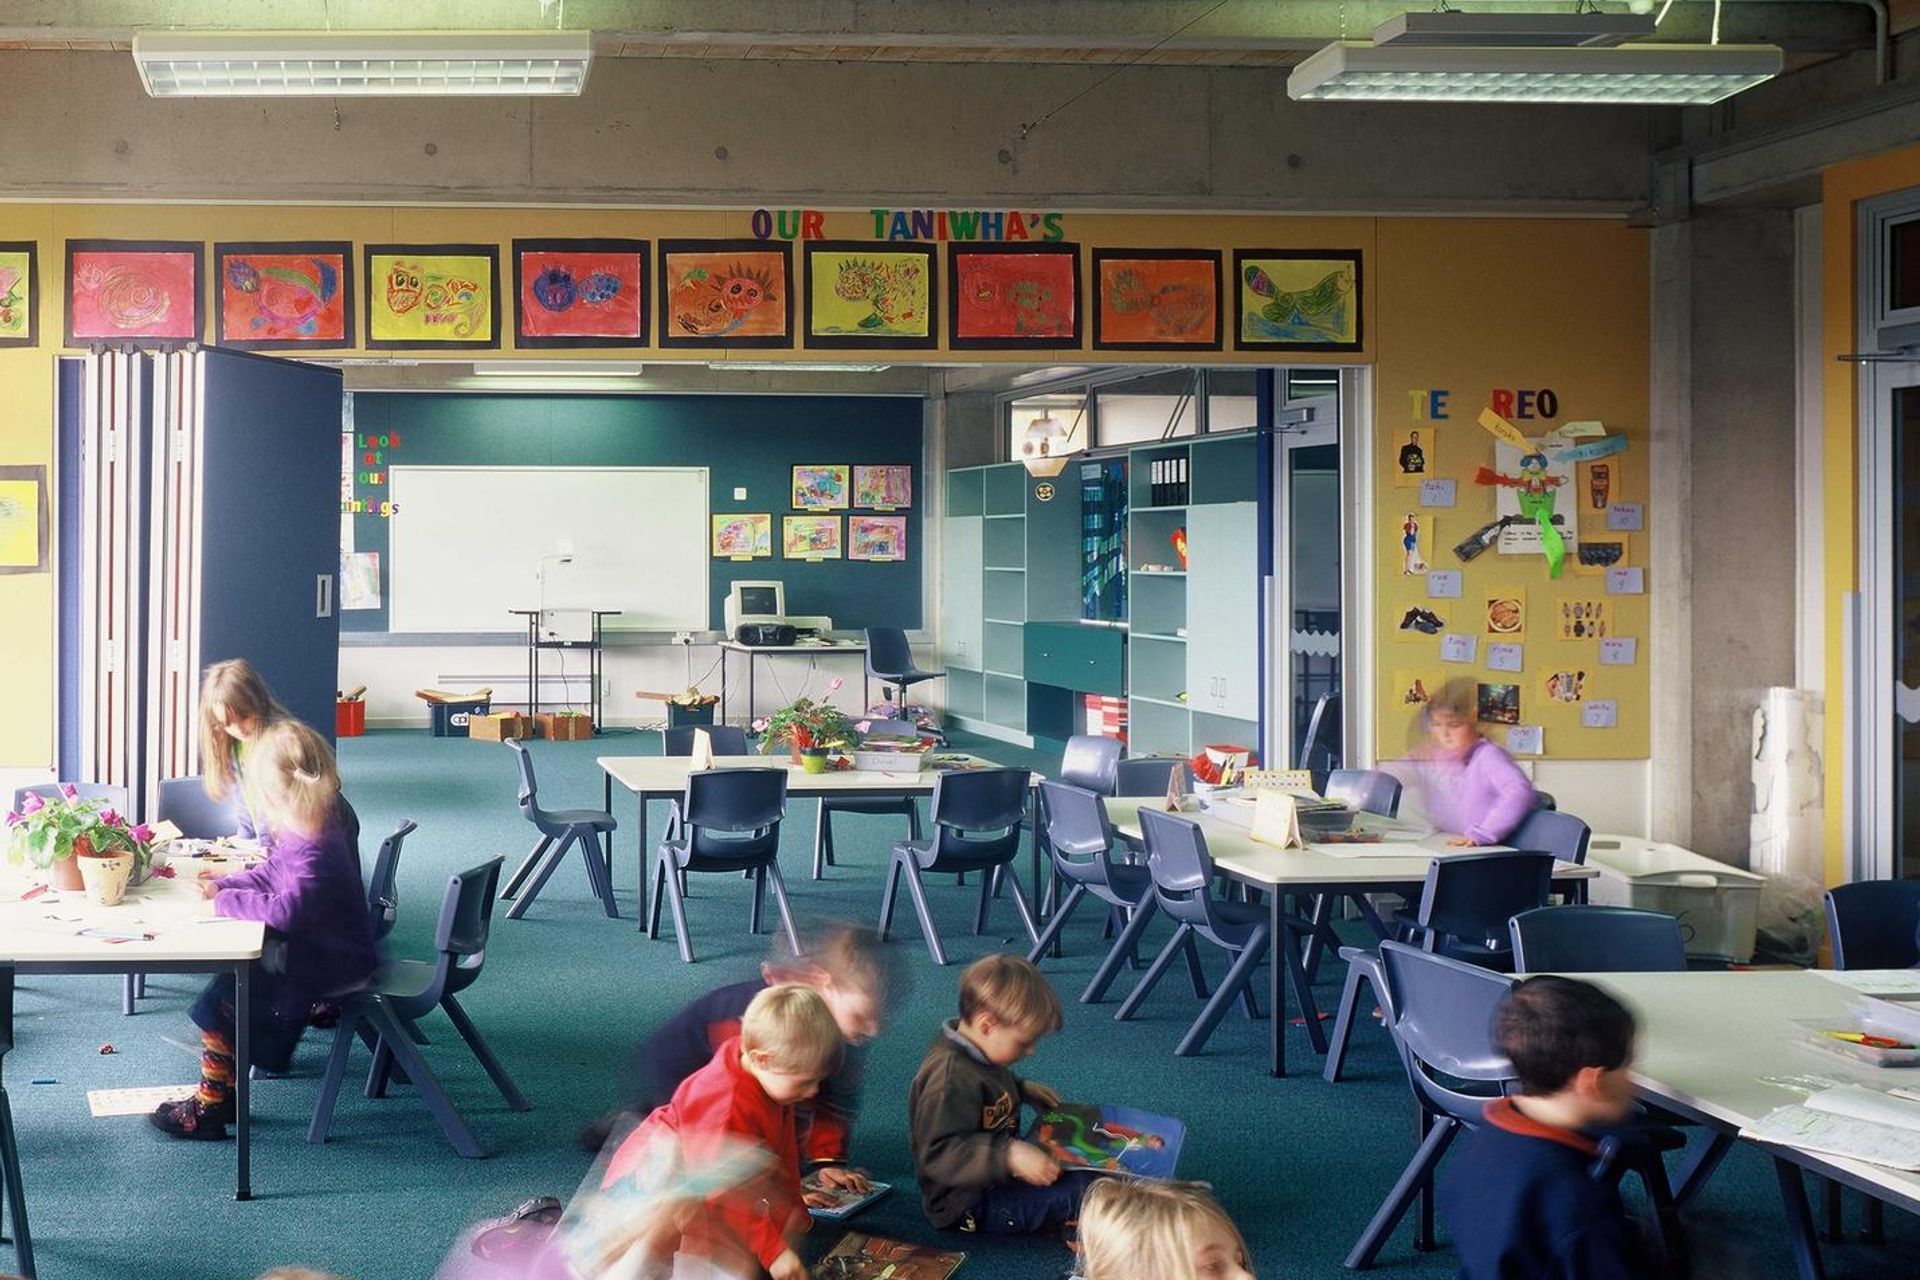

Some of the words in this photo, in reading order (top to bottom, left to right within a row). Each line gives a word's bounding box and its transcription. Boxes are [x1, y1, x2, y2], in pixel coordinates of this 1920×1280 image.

[752, 209, 826, 240] OUR
[870, 209, 1064, 242] TANIWHA'S
[1408, 389, 1449, 420] TE
[1492, 388, 1559, 419] REO
[358, 432, 400, 449] Look
[363, 451, 382, 466] at
[359, 472, 385, 485] our
